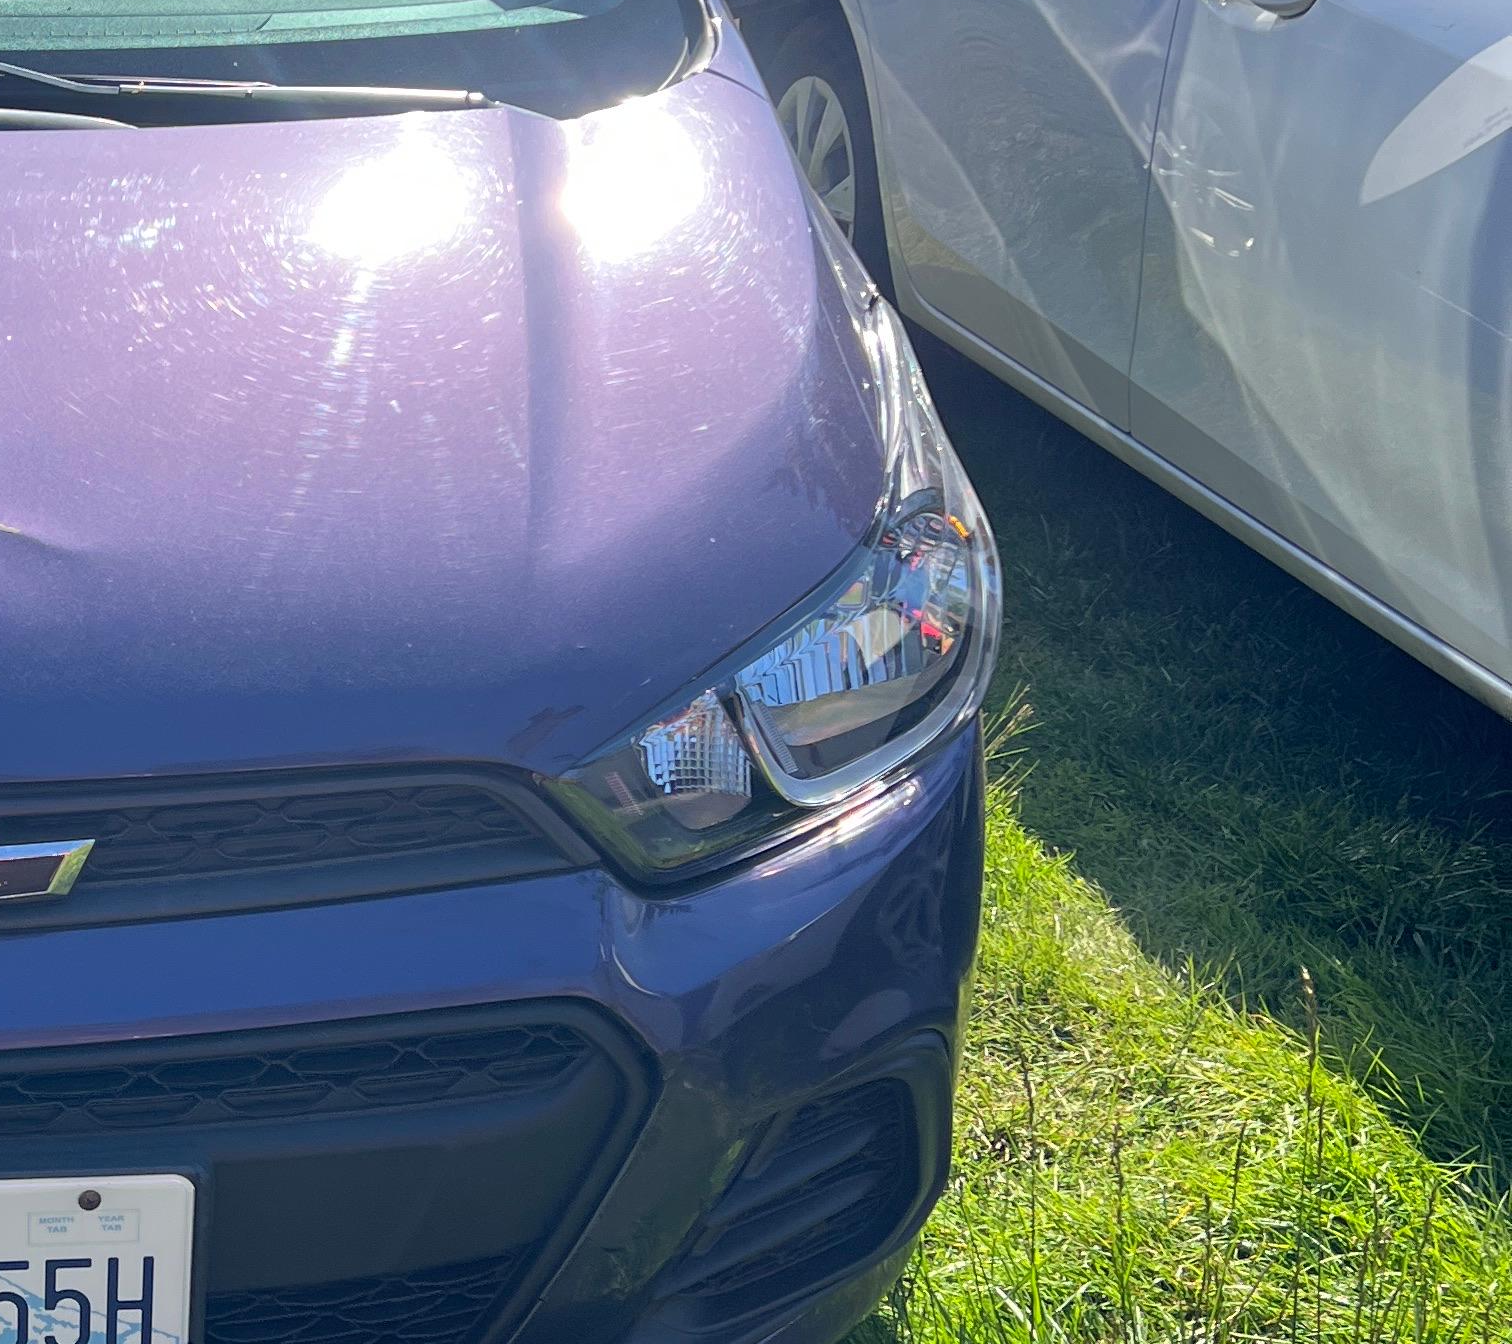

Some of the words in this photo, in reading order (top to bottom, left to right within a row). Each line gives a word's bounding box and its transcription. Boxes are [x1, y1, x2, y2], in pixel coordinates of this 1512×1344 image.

[39, 1216, 74, 1225] MONTH
[98, 1215, 124, 1223] YEAR
[47, 1225, 67, 1234] TAB
[102, 1224, 122, 1232] TAB
